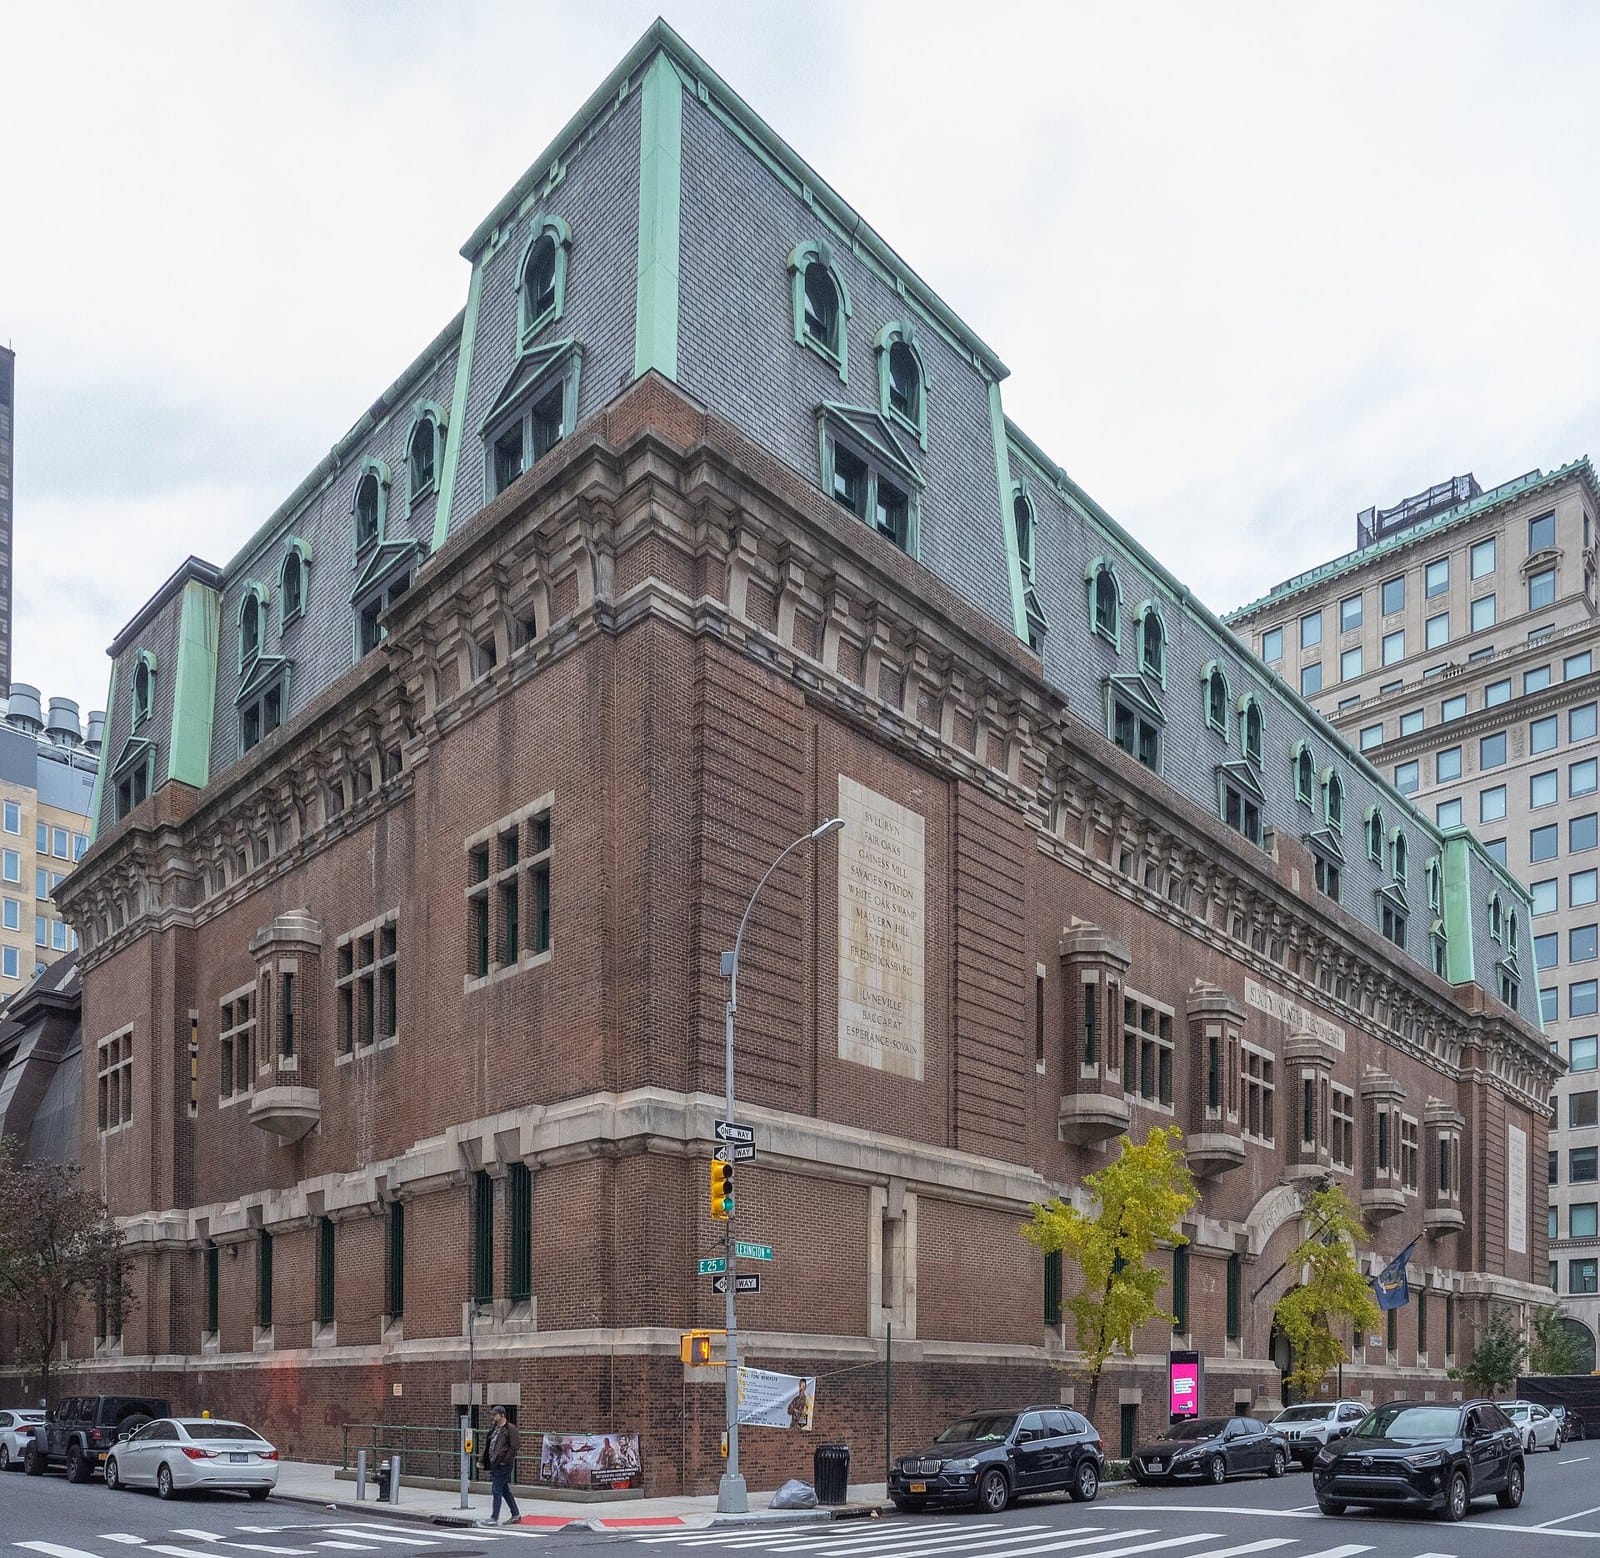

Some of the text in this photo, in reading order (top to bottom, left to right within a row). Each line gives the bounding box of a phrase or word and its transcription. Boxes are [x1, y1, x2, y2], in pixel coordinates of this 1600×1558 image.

[864, 831, 901, 856] FAIR OAKS
[891, 863, 908, 879] MILL
[848, 884, 872, 902] WHITE
[874, 895, 891, 911] OAK
[883, 879, 914, 899] STATION
[856, 907, 910, 938] MALVERN HILL
[862, 990, 903, 1012] LVNEVILLE
[862, 1010, 903, 1030] BACCARAT
[720, 1127, 749, 1139] ONE WAY
[737, 1148, 750, 1157] WAY
[736, 1242, 765, 1258] LEXINGTON
[700, 1261, 705, 1272] E
[707, 1260, 718, 1271] 25
[739, 1280, 754, 1288] WAY
